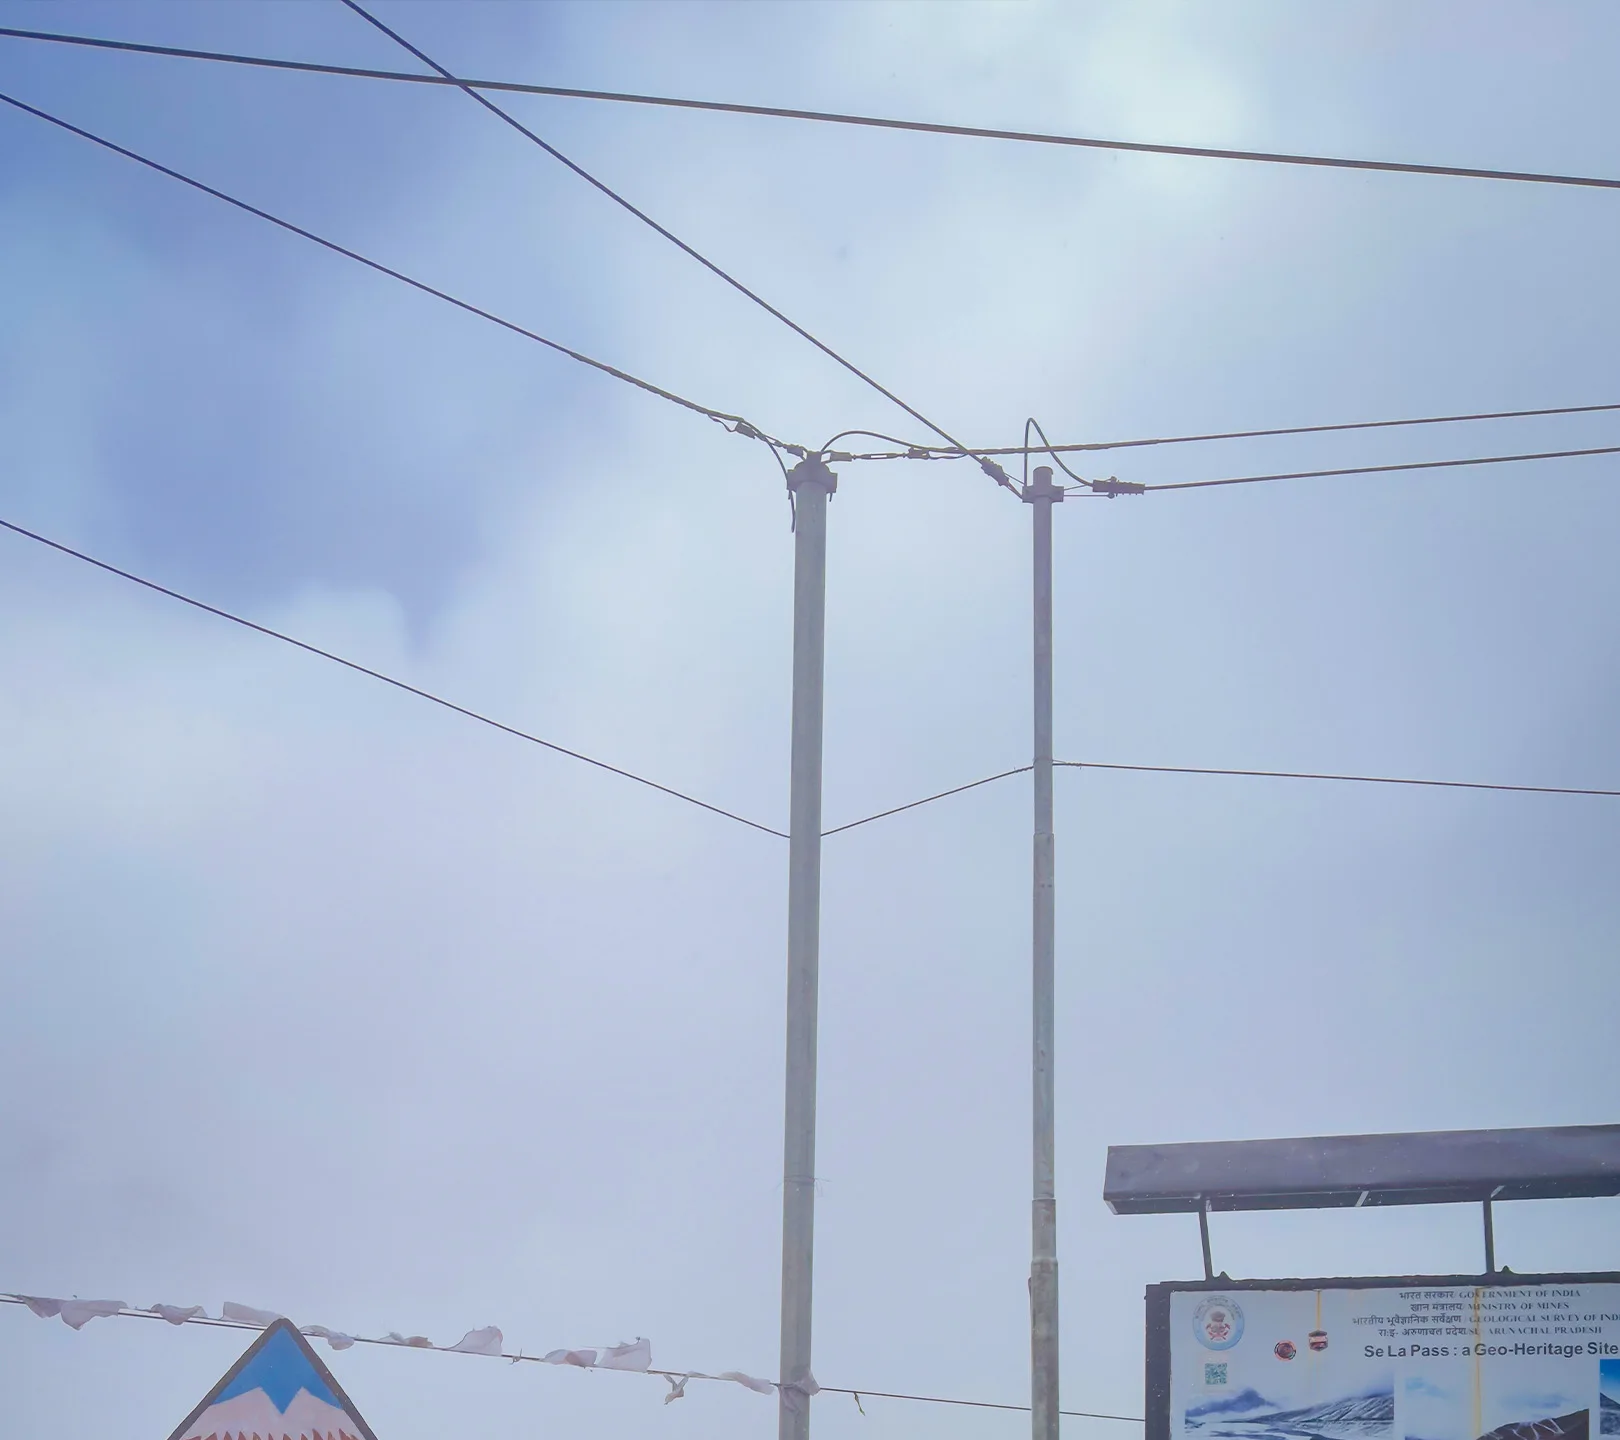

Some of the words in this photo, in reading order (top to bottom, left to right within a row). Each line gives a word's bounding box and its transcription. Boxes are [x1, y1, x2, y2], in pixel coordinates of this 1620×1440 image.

[1399, 1291, 1422, 1300] भारत
[1410, 1303, 1429, 1312] खान
[1468, 1302, 1516, 1310] MINISTRY
[1352, 1314, 1384, 1325] भारतीय
[1431, 1313, 1462, 1324] सर्वेक्षण
[1469, 1315, 1536, 1323] GEOLOGICAL
[1541, 1314, 1579, 1322] SURVEY
[1402, 1328, 1443, 1336] अरुणाचल
[1445, 1325, 1467, 1336] प्रदेश
[1555, 1326, 1601, 1334] PRADESH
[1364, 1345, 1384, 1358] Se
[1388, 1345, 1406, 1357] La
[1411, 1344, 1449, 1356] Pass
[1462, 1347, 1470, 1356] a
[1474, 1342, 1583, 1358] Geo-Heritage
[1587, 1342, 1618, 1355] Site
